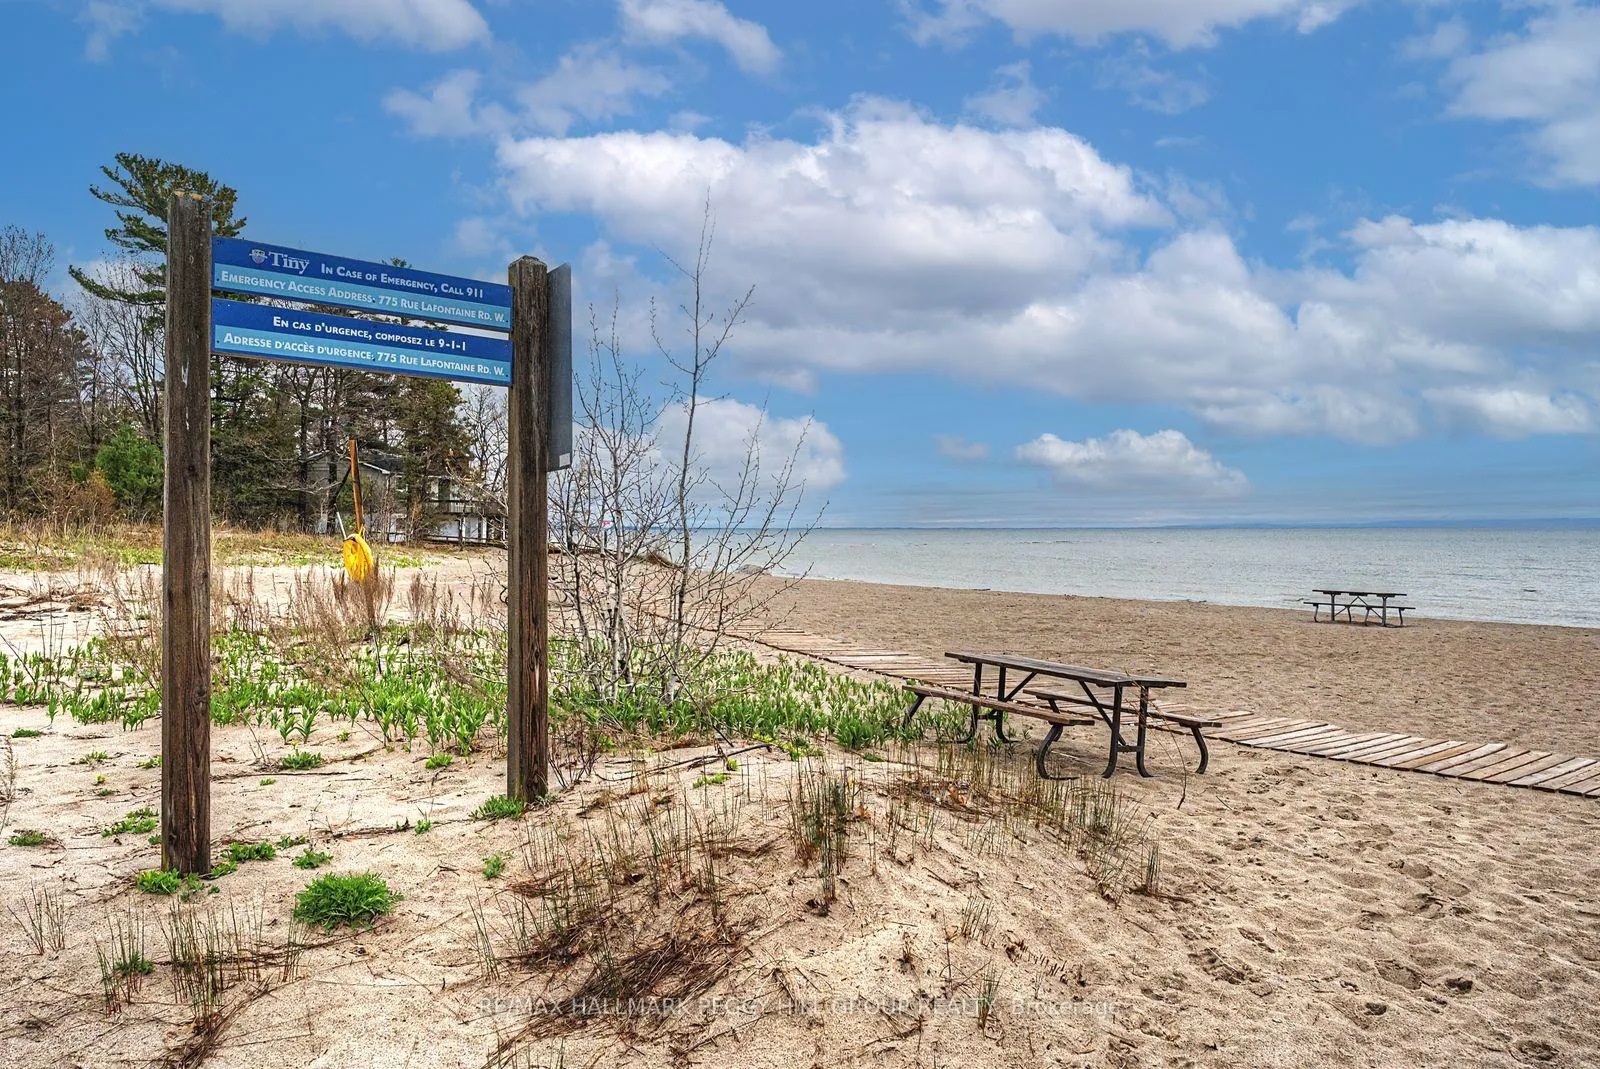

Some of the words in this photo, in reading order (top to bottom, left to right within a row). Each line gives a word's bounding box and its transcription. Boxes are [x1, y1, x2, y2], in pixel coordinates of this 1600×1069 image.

[268, 251, 310, 274] Tiny
[221, 270, 286, 290] EMERGENCY
[288, 281, 326, 296] ACCESS
[378, 295, 398, 306] 775
[400, 298, 418, 310] RUE
[422, 301, 476, 318] LAFONTAINE
[478, 310, 492, 321] RD.
[494, 312, 505, 322] W.
[321, 263, 333, 275] IN
[336, 266, 363, 280] CASE
[365, 273, 378, 282] OF
[380, 273, 438, 293] EMERGENCY,
[441, 283, 464, 296] CALL
[466, 287, 483, 298] 911
[273, 316, 288, 328] EN
[292, 321, 312, 330] CAS
[315, 322, 372, 340] D'URGENCE,
[375, 332, 422, 346] COMPOSEZ
[425, 338, 435, 347] LE
[438, 338, 466, 351] 9-1-1
[224, 332, 272, 348] ADRESSE
[274, 340, 314, 353] D'ACCÈS
[376, 352, 397, 362] 775
[400, 354, 418, 366] RUE
[420, 357, 476, 372] LAFONTAINE
[478, 364, 492, 374] RD.
[494, 366, 505, 376] W.
